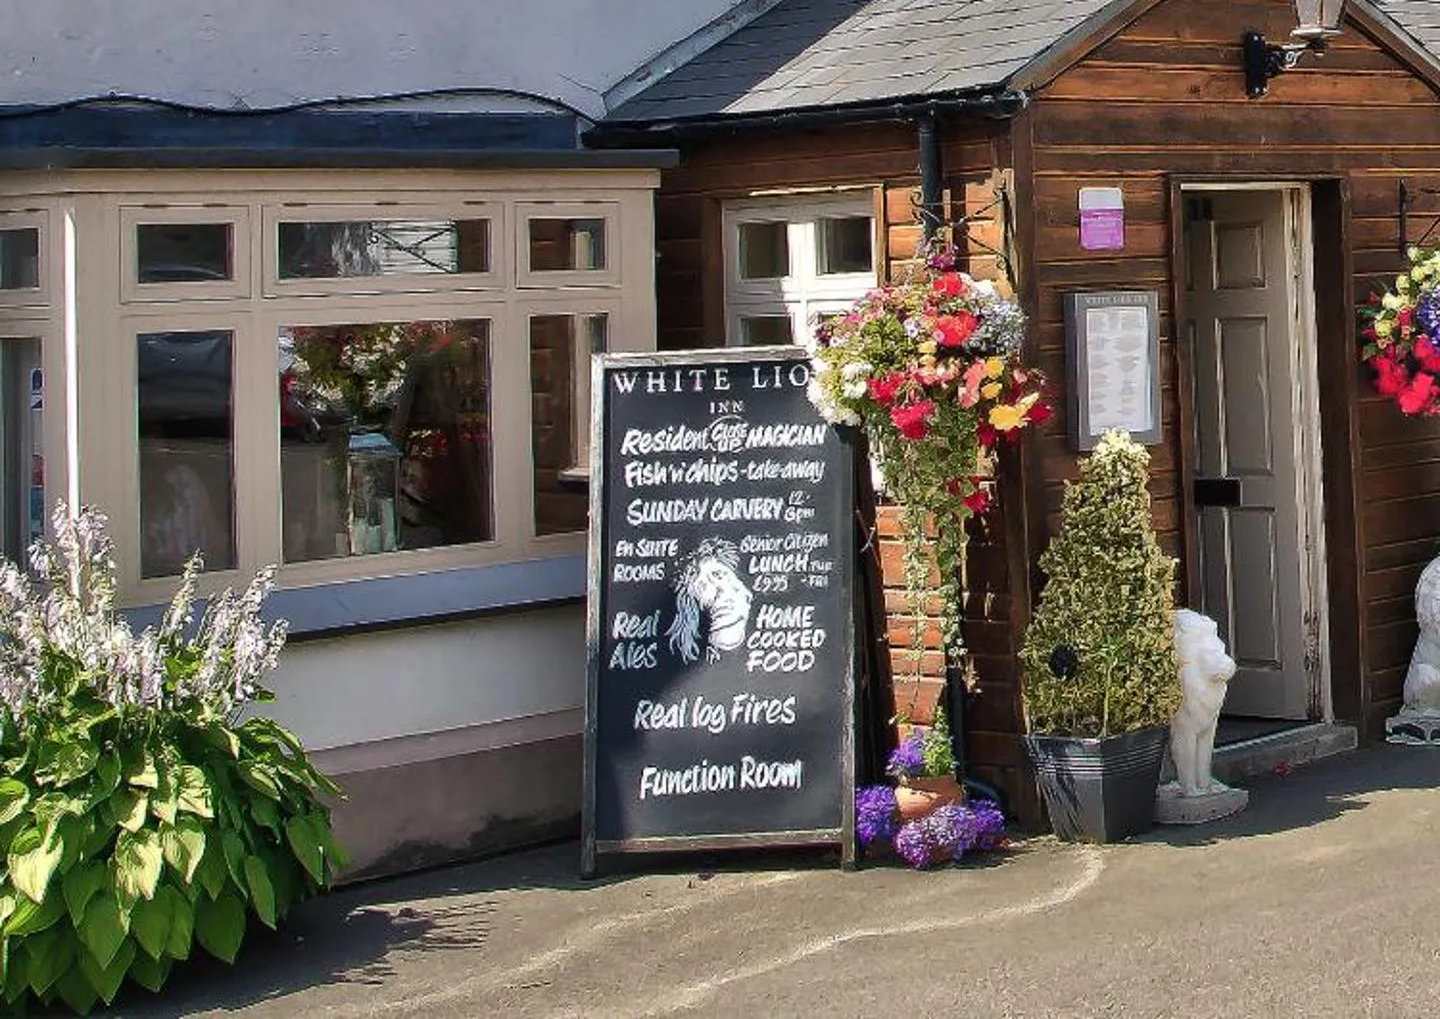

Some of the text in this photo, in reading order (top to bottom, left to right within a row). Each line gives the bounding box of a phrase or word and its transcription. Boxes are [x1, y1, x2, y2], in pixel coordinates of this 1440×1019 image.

[613, 364, 810, 394] WHITE LIO
[709, 400, 744, 414] INN
[620, 424, 711, 455] Resident
[745, 423, 827, 449] MAGICIAN
[624, 461, 667, 488] Fish
[626, 497, 784, 527] SUNDAY CARVERY
[635, 538, 679, 557] SUITE
[740, 531, 829, 553] Senior Citizen
[613, 562, 665, 582] ROOMS
[748, 553, 809, 574] LUNCH
[612, 609, 661, 640] Real
[755, 605, 816, 630] HOME
[746, 629, 827, 650] COOKED
[608, 641, 658, 670] Ales
[746, 651, 816, 673] FOOD
[633, 693, 797, 734] Real log Fires
[638, 755, 804, 800] Function Room
